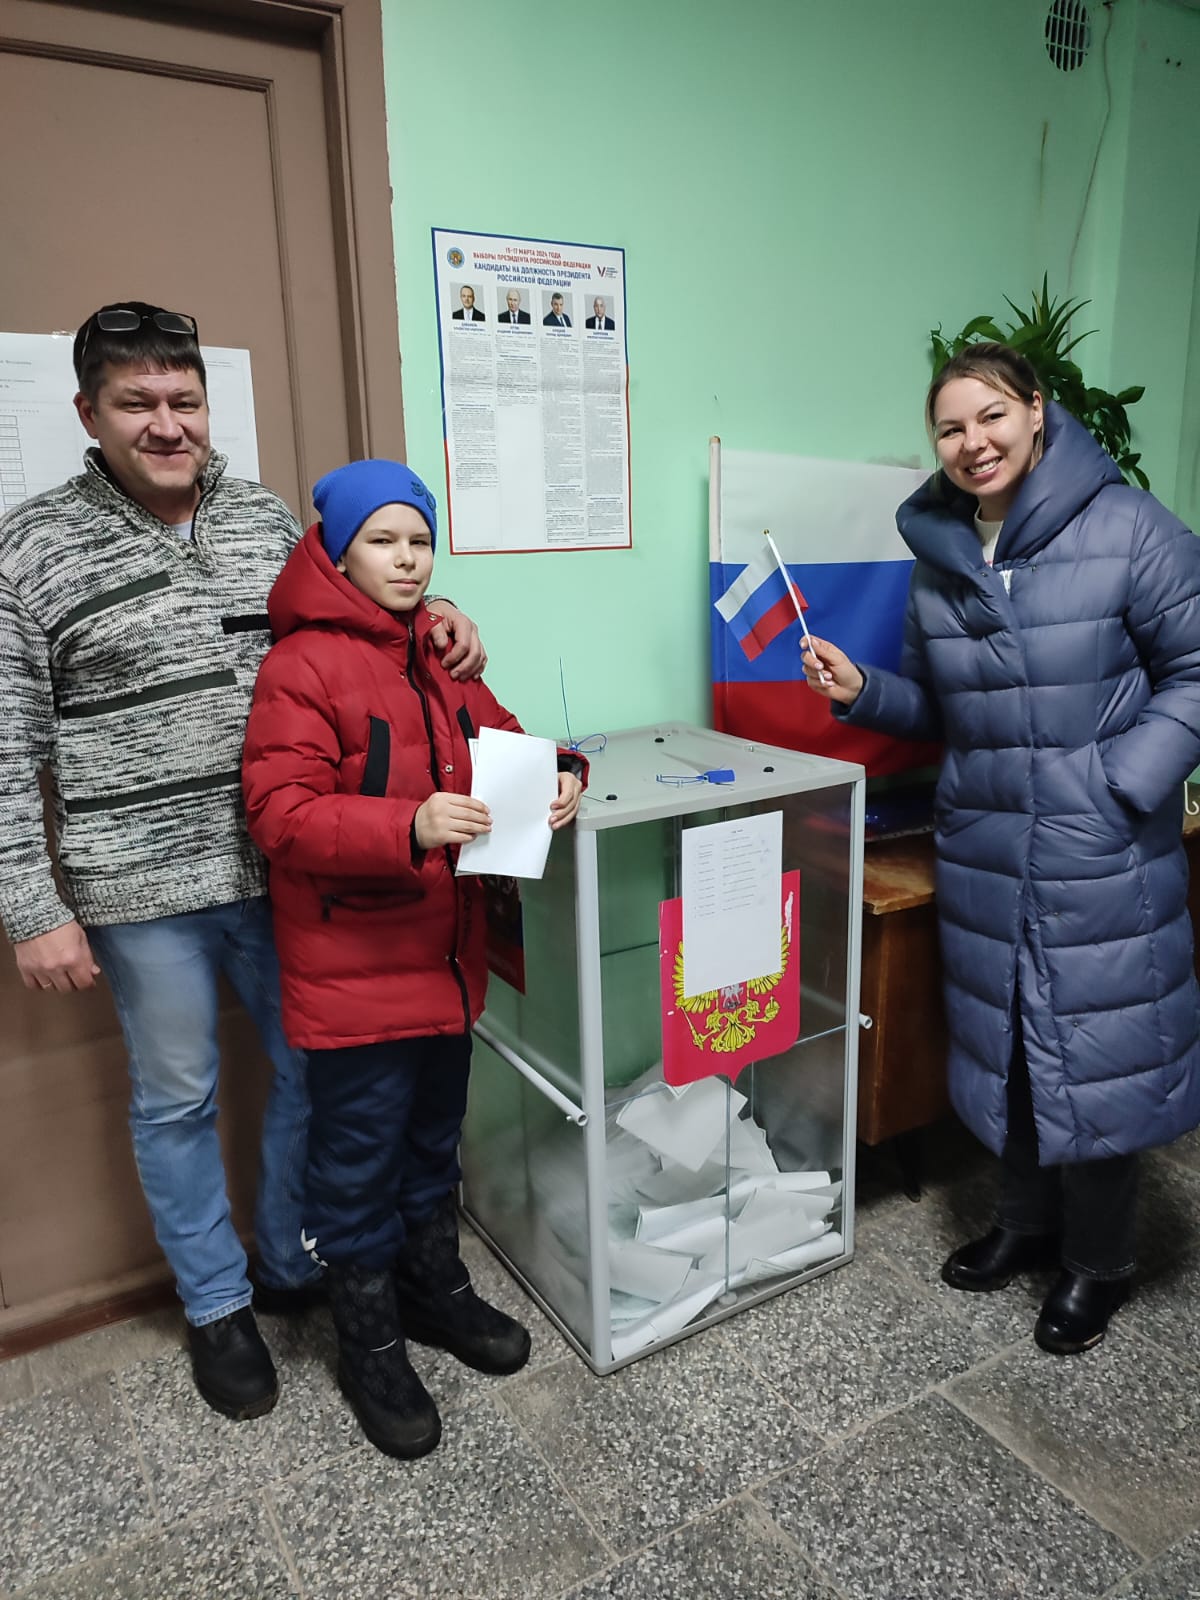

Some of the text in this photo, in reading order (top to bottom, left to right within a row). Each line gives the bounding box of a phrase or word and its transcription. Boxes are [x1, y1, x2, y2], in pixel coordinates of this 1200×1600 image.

[473, 252, 591, 269] ВЫБОРЫ ПРЕЗИДЕНТА РОССИЙСКОЙ ФЕДЕРАЦИИ
[518, 248, 535, 256] МАРТА
[548, 251, 561, 259] ГОДА
[474, 262, 591, 280] КАНДИДАТЫ НА ДОЛЖНОСТЬ ПРЕЗИДЕНТА
[497, 273, 571, 287] РОССИЙСКОЙ ФЕДЕРАЦИИ
